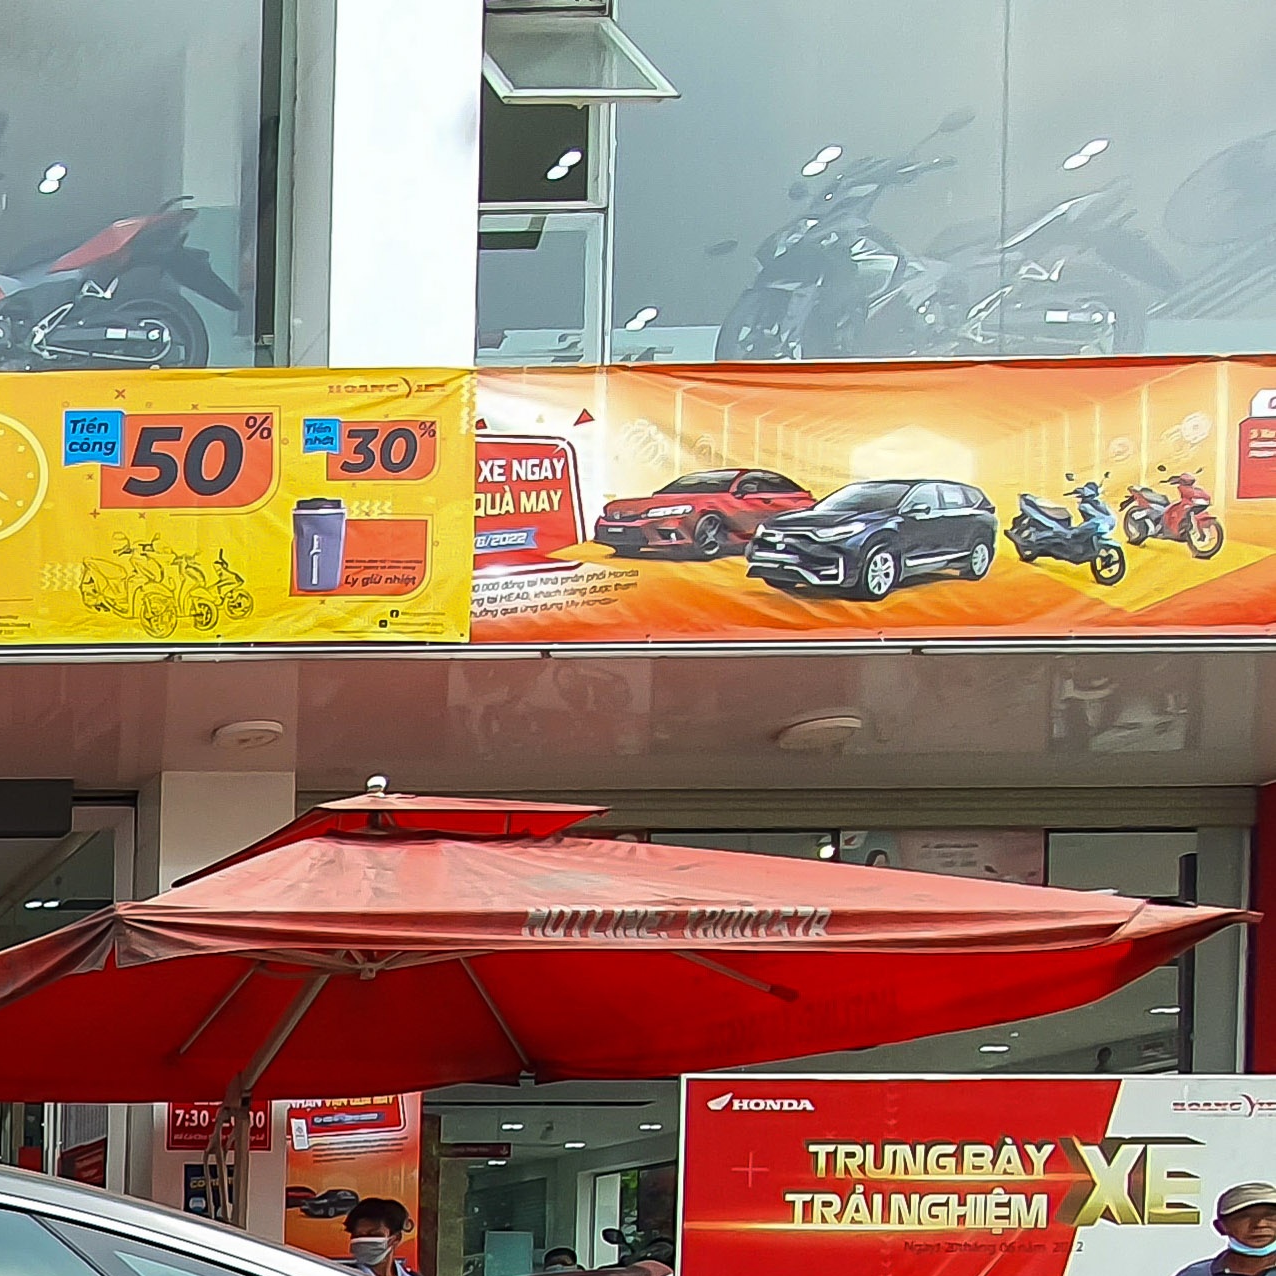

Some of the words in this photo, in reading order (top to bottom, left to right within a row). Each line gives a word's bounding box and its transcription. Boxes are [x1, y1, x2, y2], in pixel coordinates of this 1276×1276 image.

[67, 436, 116, 456] công
[478, 459, 506, 483] XE
[512, 458, 565, 482] NGAY
[473, 485, 515, 517] QUÀ
[520, 489, 562, 513] MAY
[732, 1099, 815, 1111] HONDA
[175, 1110, 209, 1127] 7:30
[1073, 1142, 1202, 1226] XE
[784, 1185, 883, 1227] TRẢI
[889, 1187, 1047, 1235] NGHIỆM
